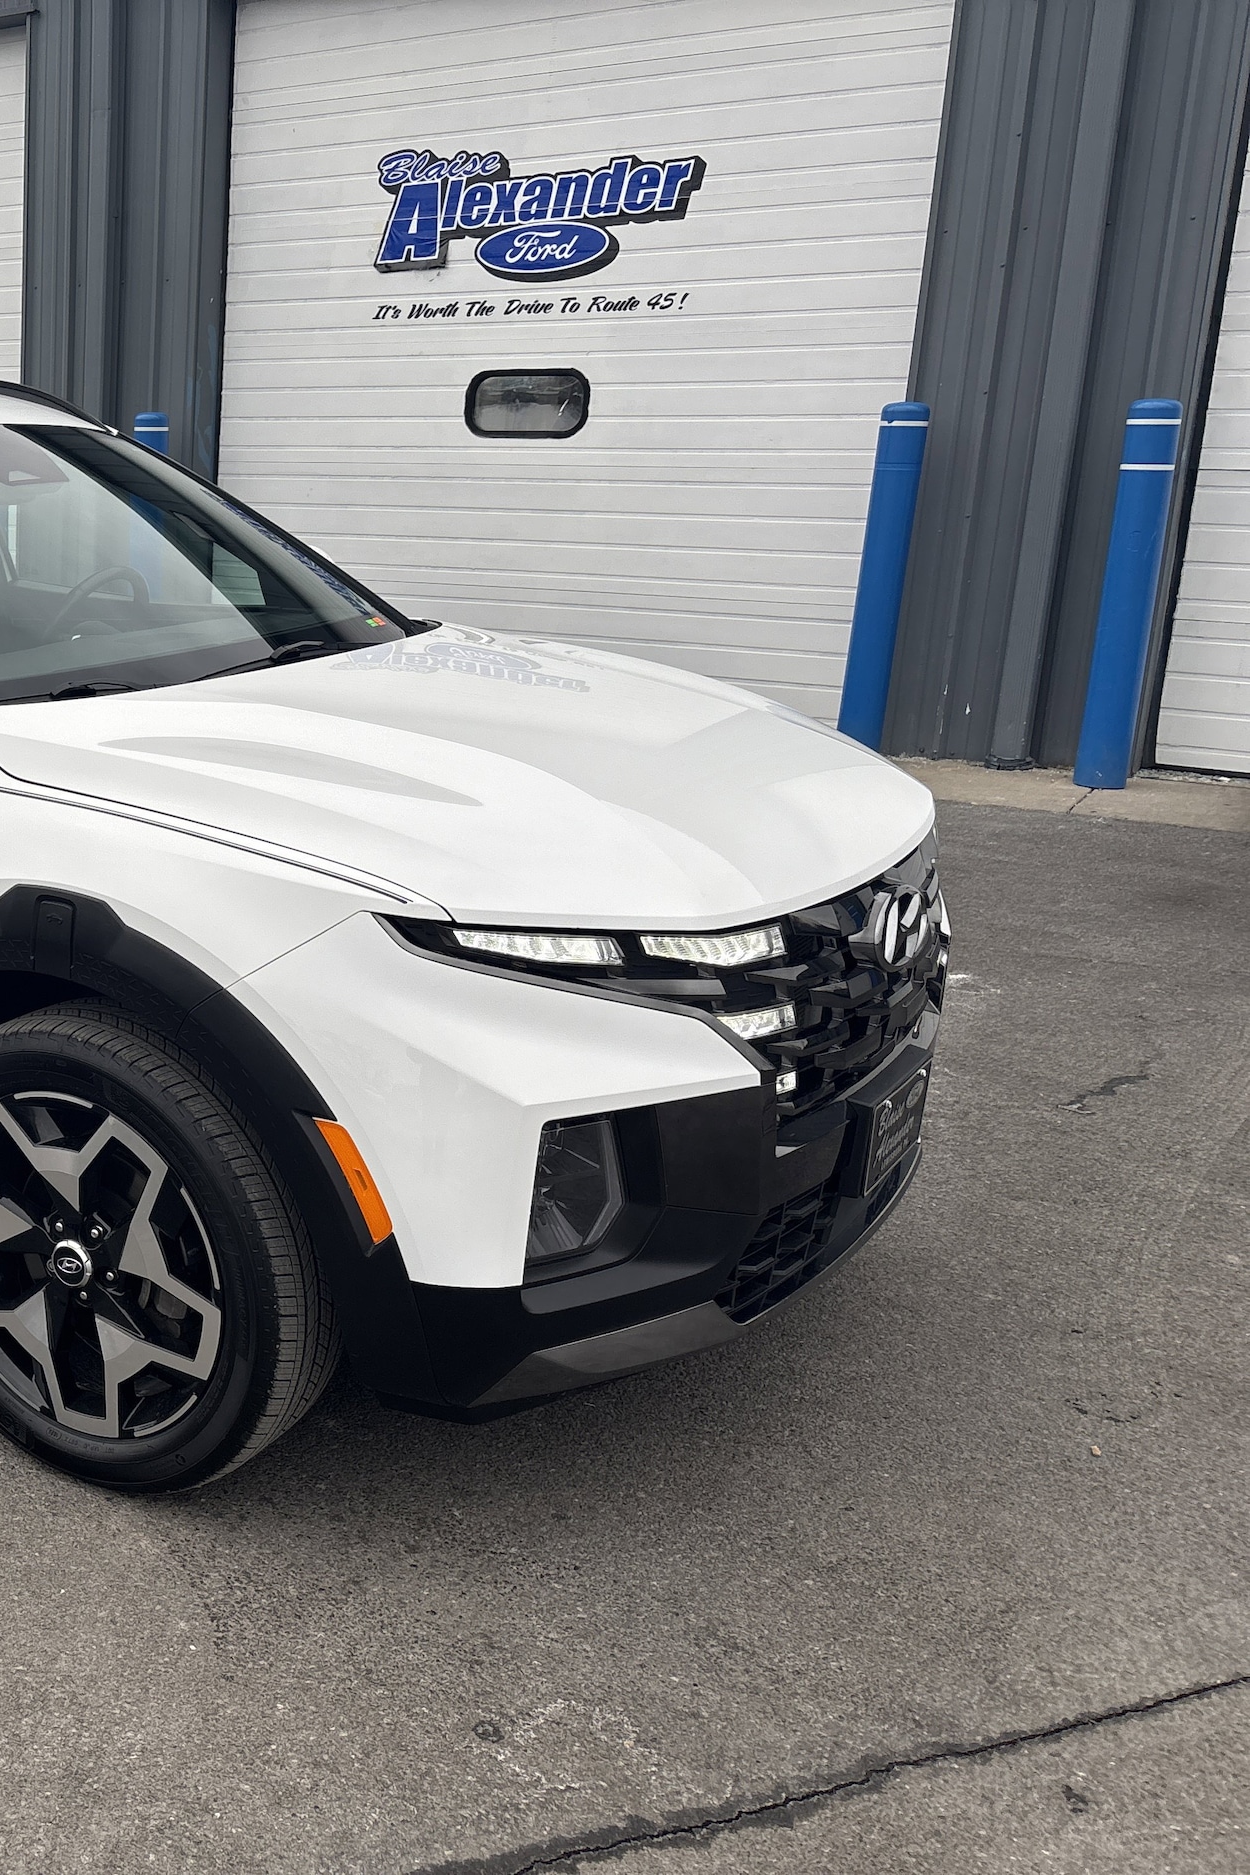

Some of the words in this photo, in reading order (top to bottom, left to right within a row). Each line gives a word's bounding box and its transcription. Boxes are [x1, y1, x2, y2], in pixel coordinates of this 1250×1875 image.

[379, 150, 507, 188] Blaise
[375, 157, 702, 268] Alexander
[505, 230, 577, 265] Ford
[372, 304, 402, 320] It's
[407, 301, 459, 320] Worth
[465, 301, 495, 317] The
[503, 299, 554, 316] Drive
[560, 296, 581, 314] To
[587, 294, 641, 313] Route
[647, 292, 690, 311] 45!
